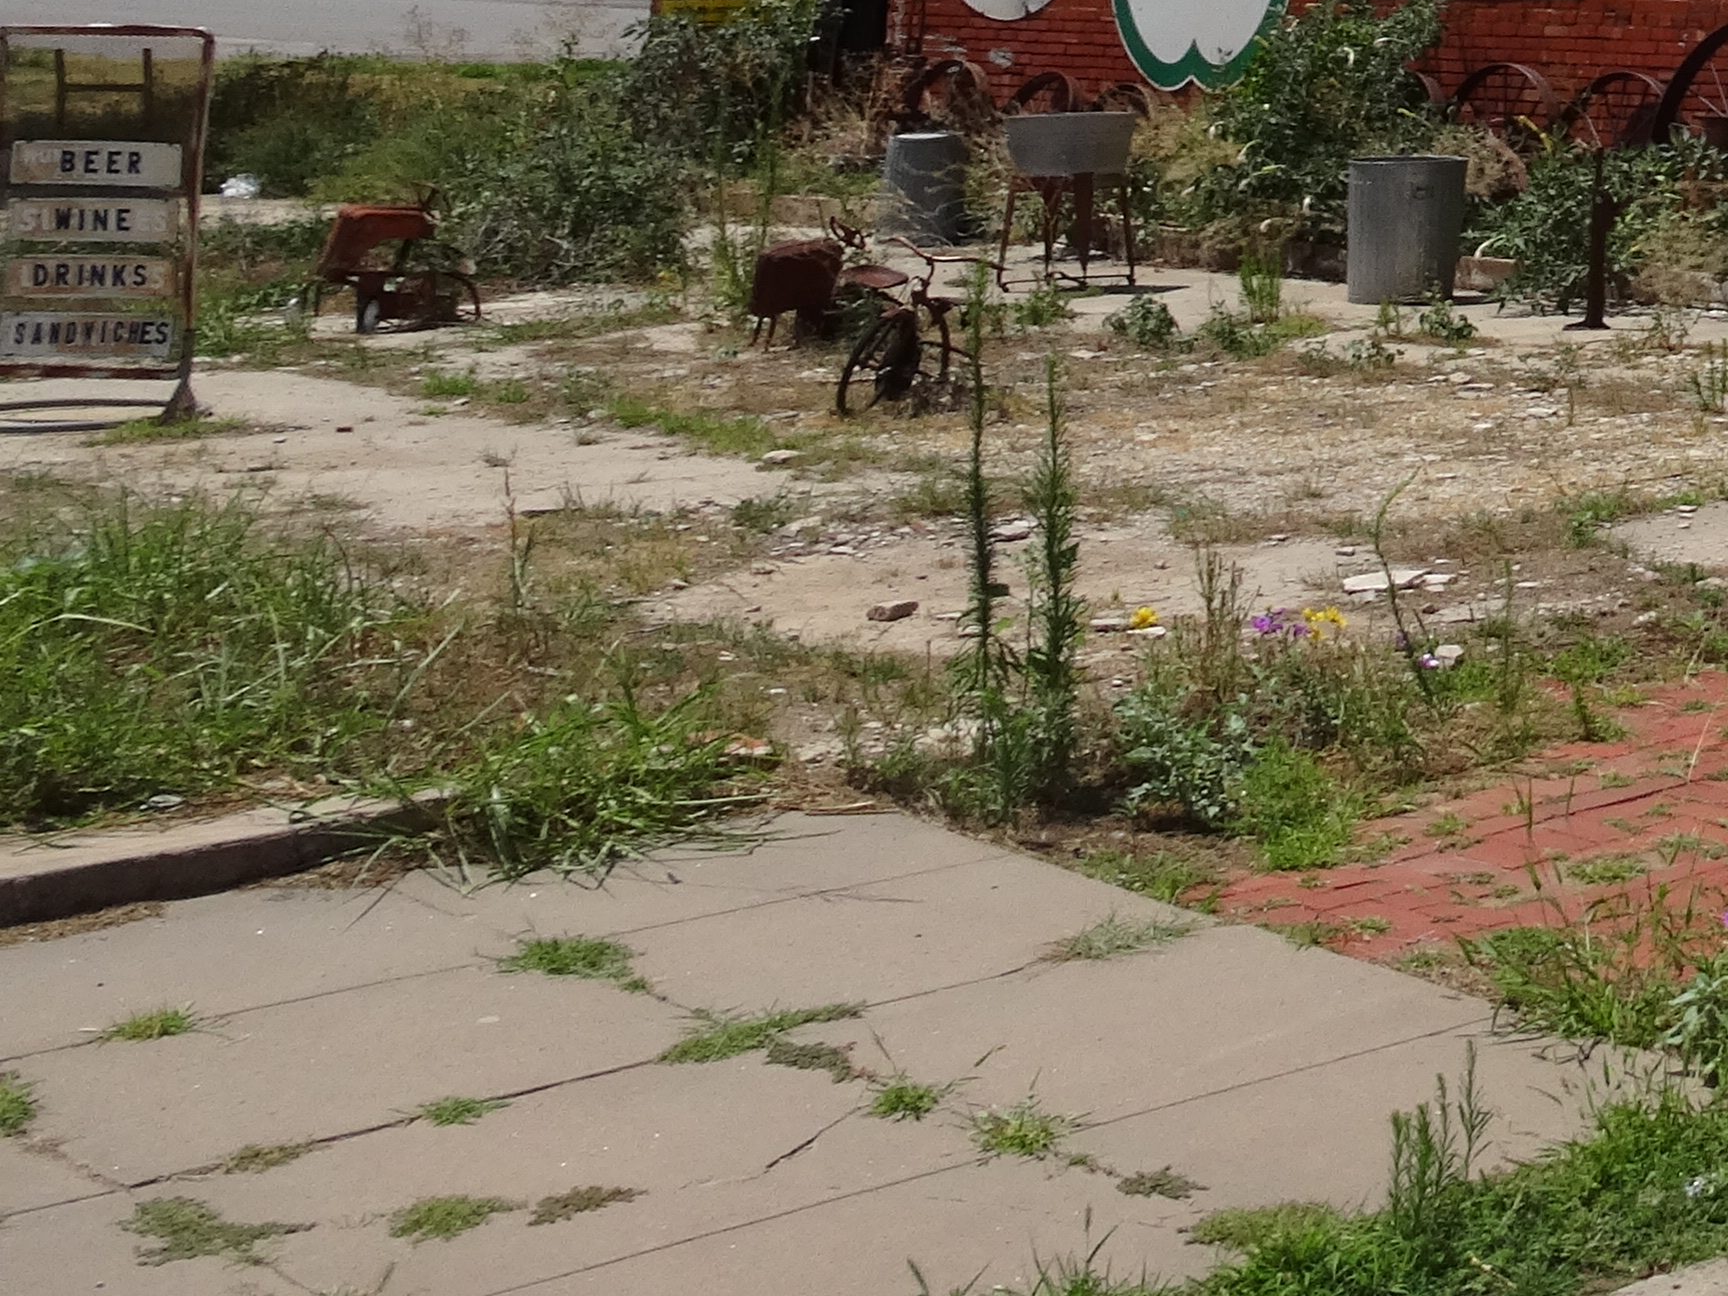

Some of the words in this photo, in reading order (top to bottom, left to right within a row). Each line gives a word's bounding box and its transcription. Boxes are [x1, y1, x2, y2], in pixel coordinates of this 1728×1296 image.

[60, 150, 142, 175] BEER
[55, 208, 132, 232] WINE
[33, 263, 148, 288] DRINKS
[14, 321, 170, 346] SANDWICHES
